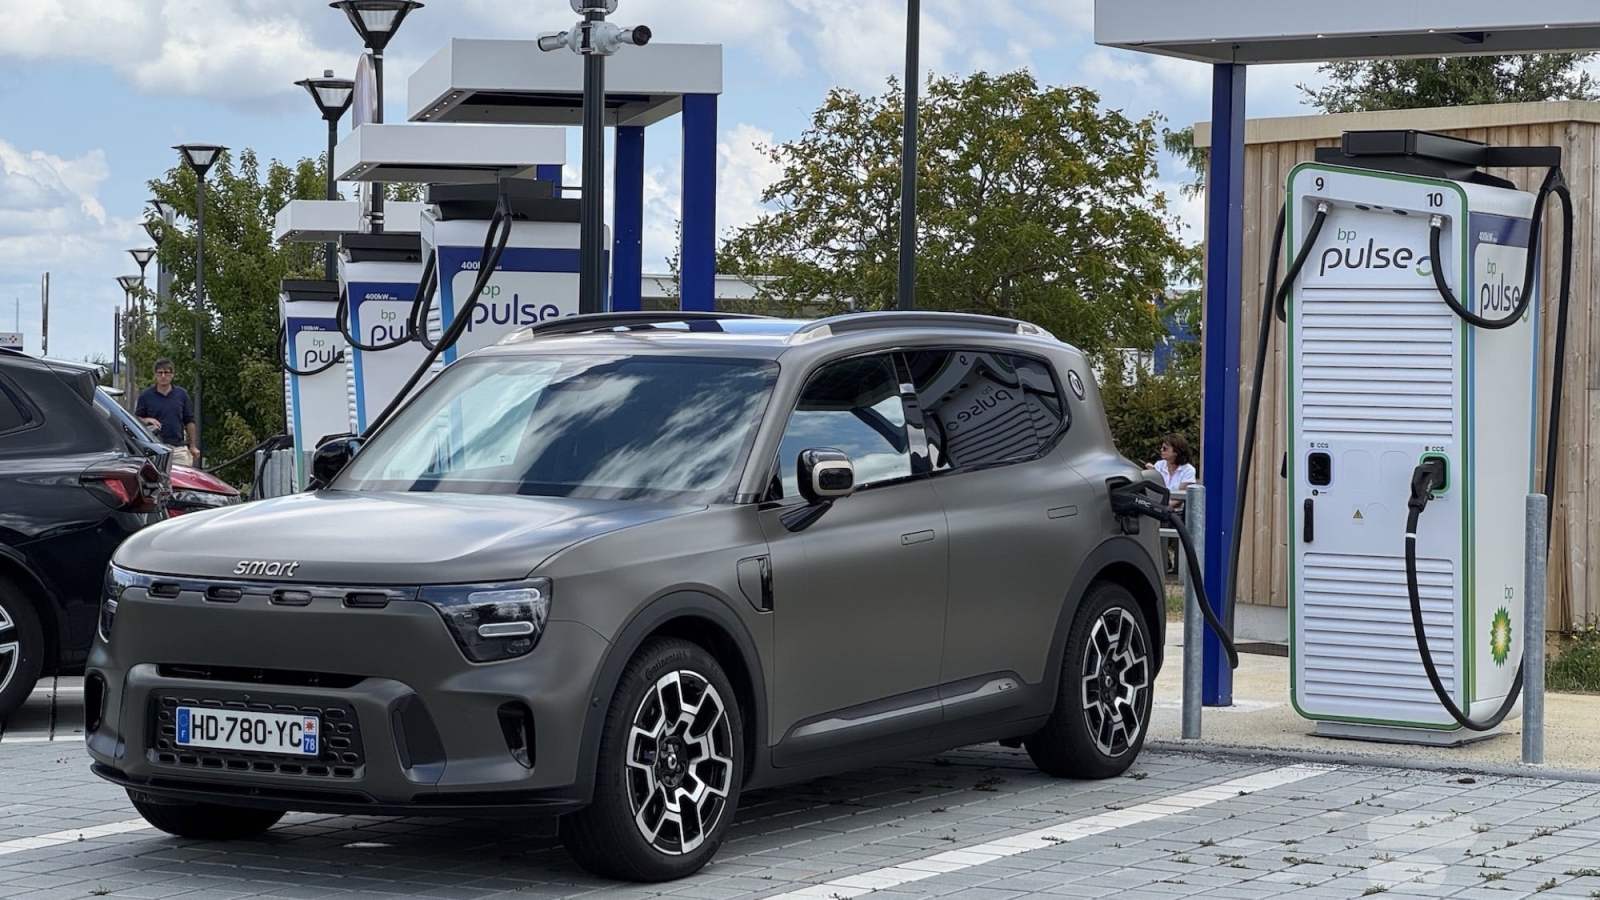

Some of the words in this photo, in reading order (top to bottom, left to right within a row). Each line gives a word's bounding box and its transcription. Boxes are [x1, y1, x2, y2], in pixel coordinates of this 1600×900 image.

[1315, 177, 1324, 191] 9
[1427, 192, 1443, 207] 10
[1337, 227, 1356, 244] bp
[1319, 238, 1413, 277] pulse
[1487, 258, 1497, 279] bp
[1480, 272, 1520, 319] pulse
[380, 309, 396, 322] bp
[466, 293, 560, 332] pulse
[371, 318, 412, 346] pul
[313, 338, 325, 348] bp
[233, 560, 300, 577] smart
[181, 730, 186, 738] F
[191, 713, 302, 748] HD-780-YC
[304, 738, 315, 751] 78
